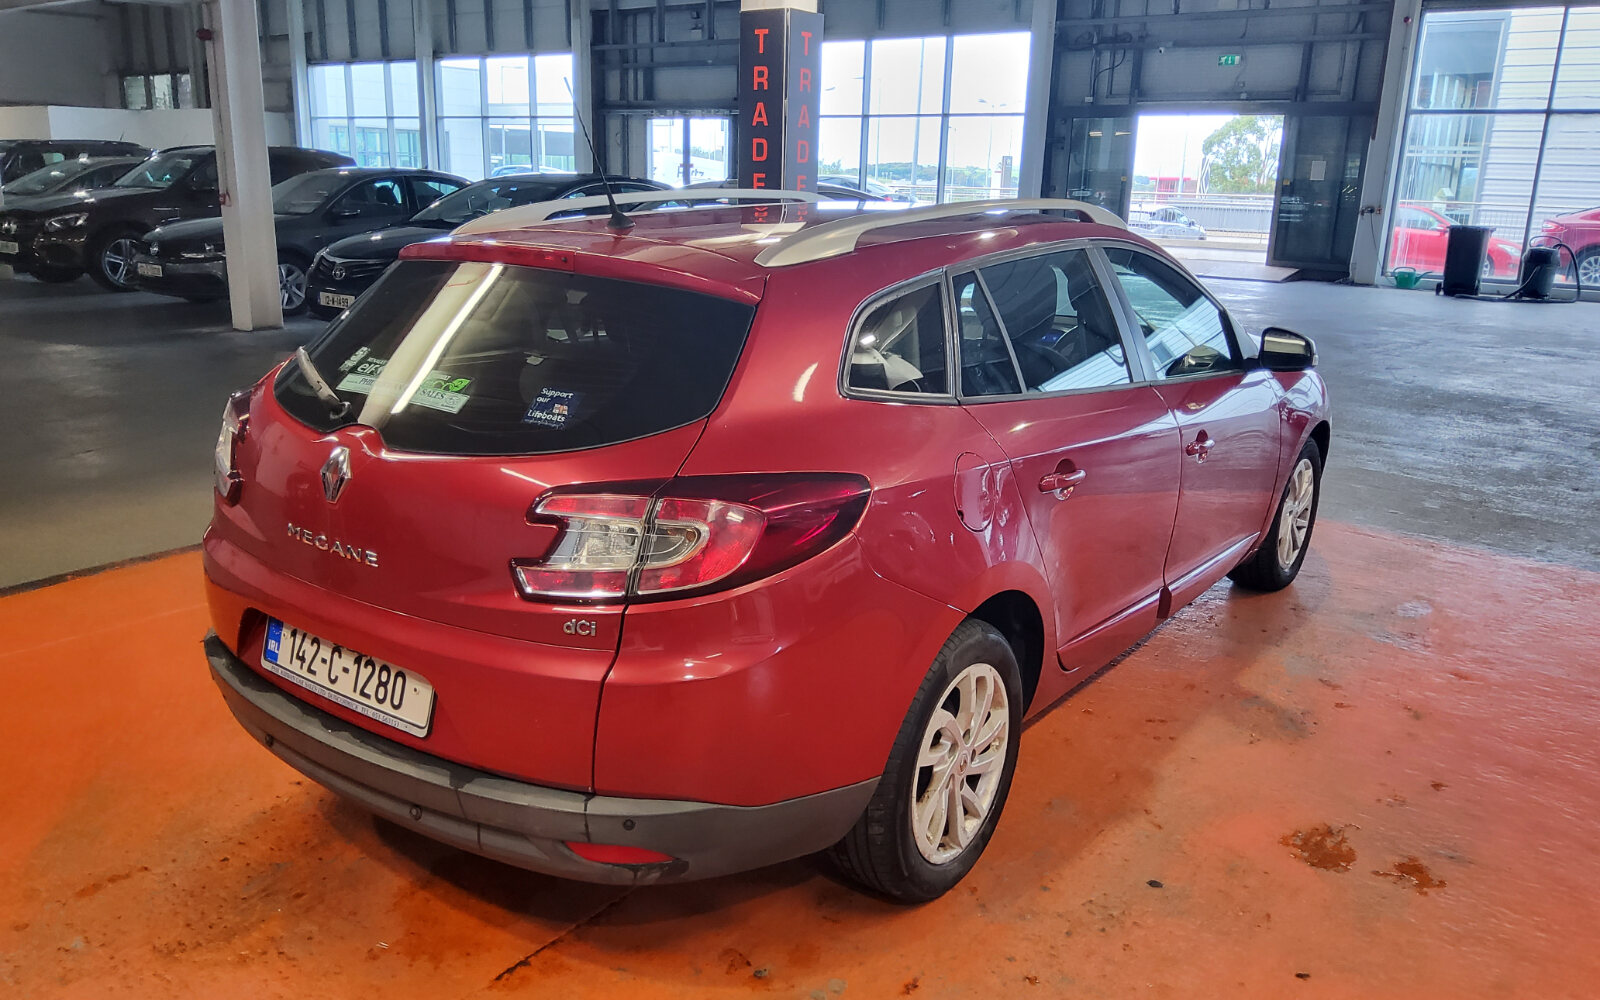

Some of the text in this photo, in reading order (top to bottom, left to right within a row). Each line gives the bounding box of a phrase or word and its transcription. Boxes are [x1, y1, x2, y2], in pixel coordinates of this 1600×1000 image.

[540, 387, 574, 399] Support
[527, 409, 566, 422] Lifeboats
[287, 522, 379, 568] MEGANE
[563, 618, 597, 637] dCi
[268, 638, 279, 654] IRL
[290, 628, 407, 710] 142-C-1280
